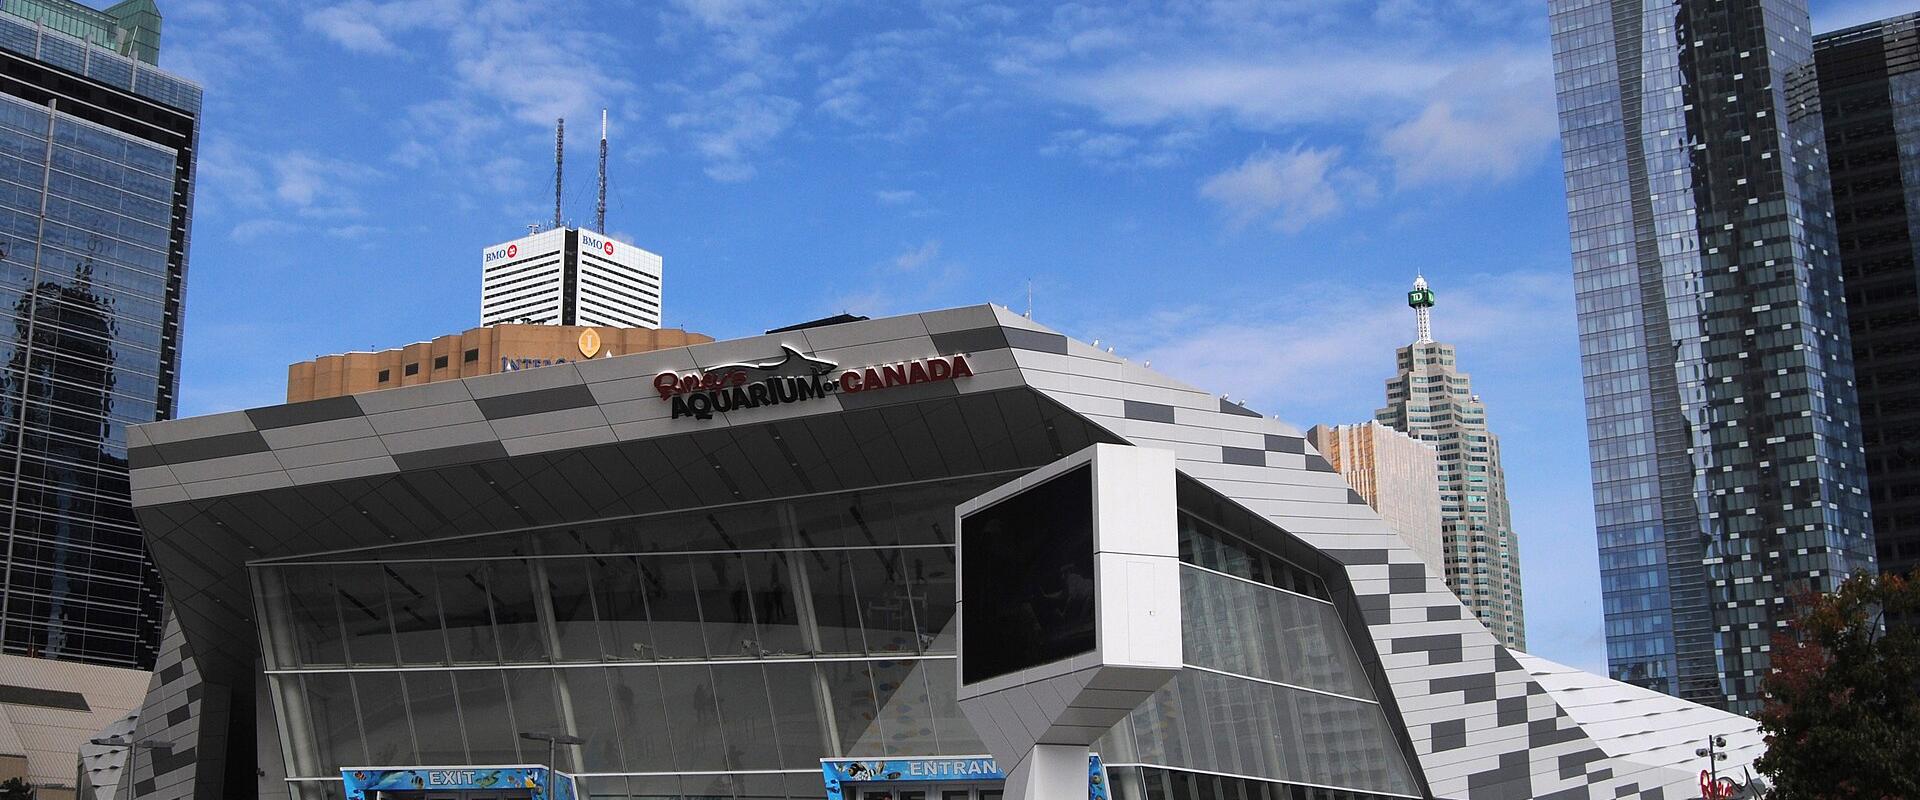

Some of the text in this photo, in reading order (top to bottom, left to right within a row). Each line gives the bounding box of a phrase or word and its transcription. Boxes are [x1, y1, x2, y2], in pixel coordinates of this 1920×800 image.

[582, 235, 602, 250] BMO
[485, 249, 506, 262] BMO
[1411, 292, 1423, 302] TD
[671, 374, 826, 420] AQUARIUM
[839, 353, 974, 394] CANADA
[909, 760, 1003, 777] ENTRAN
[428, 770, 477, 786] EXIT
